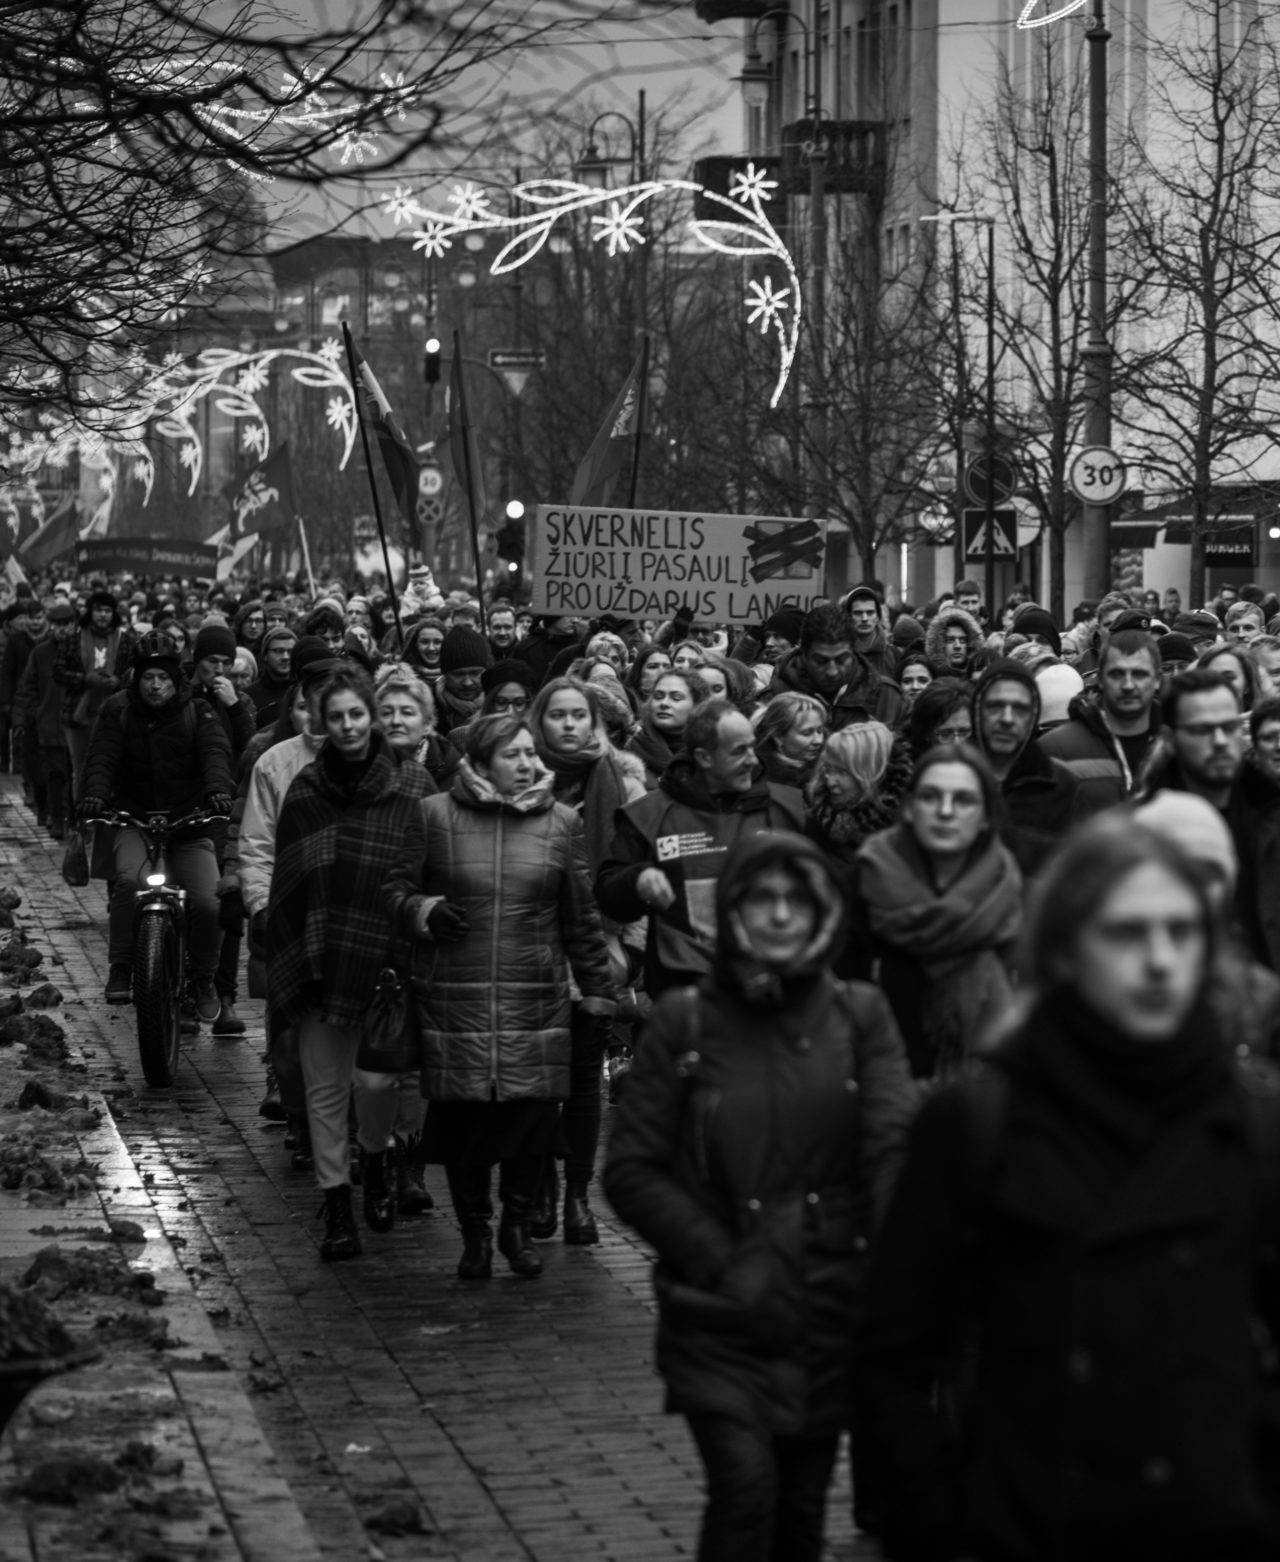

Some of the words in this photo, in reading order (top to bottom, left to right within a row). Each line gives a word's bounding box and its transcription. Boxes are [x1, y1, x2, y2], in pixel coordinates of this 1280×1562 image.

[1083, 465, 1113, 486] 30
[546, 511, 705, 550] SKVERNELIS
[641, 552, 749, 587] PASAULĮ
[546, 579, 591, 610] PRO
[596, 582, 716, 616] UŽDARUS
